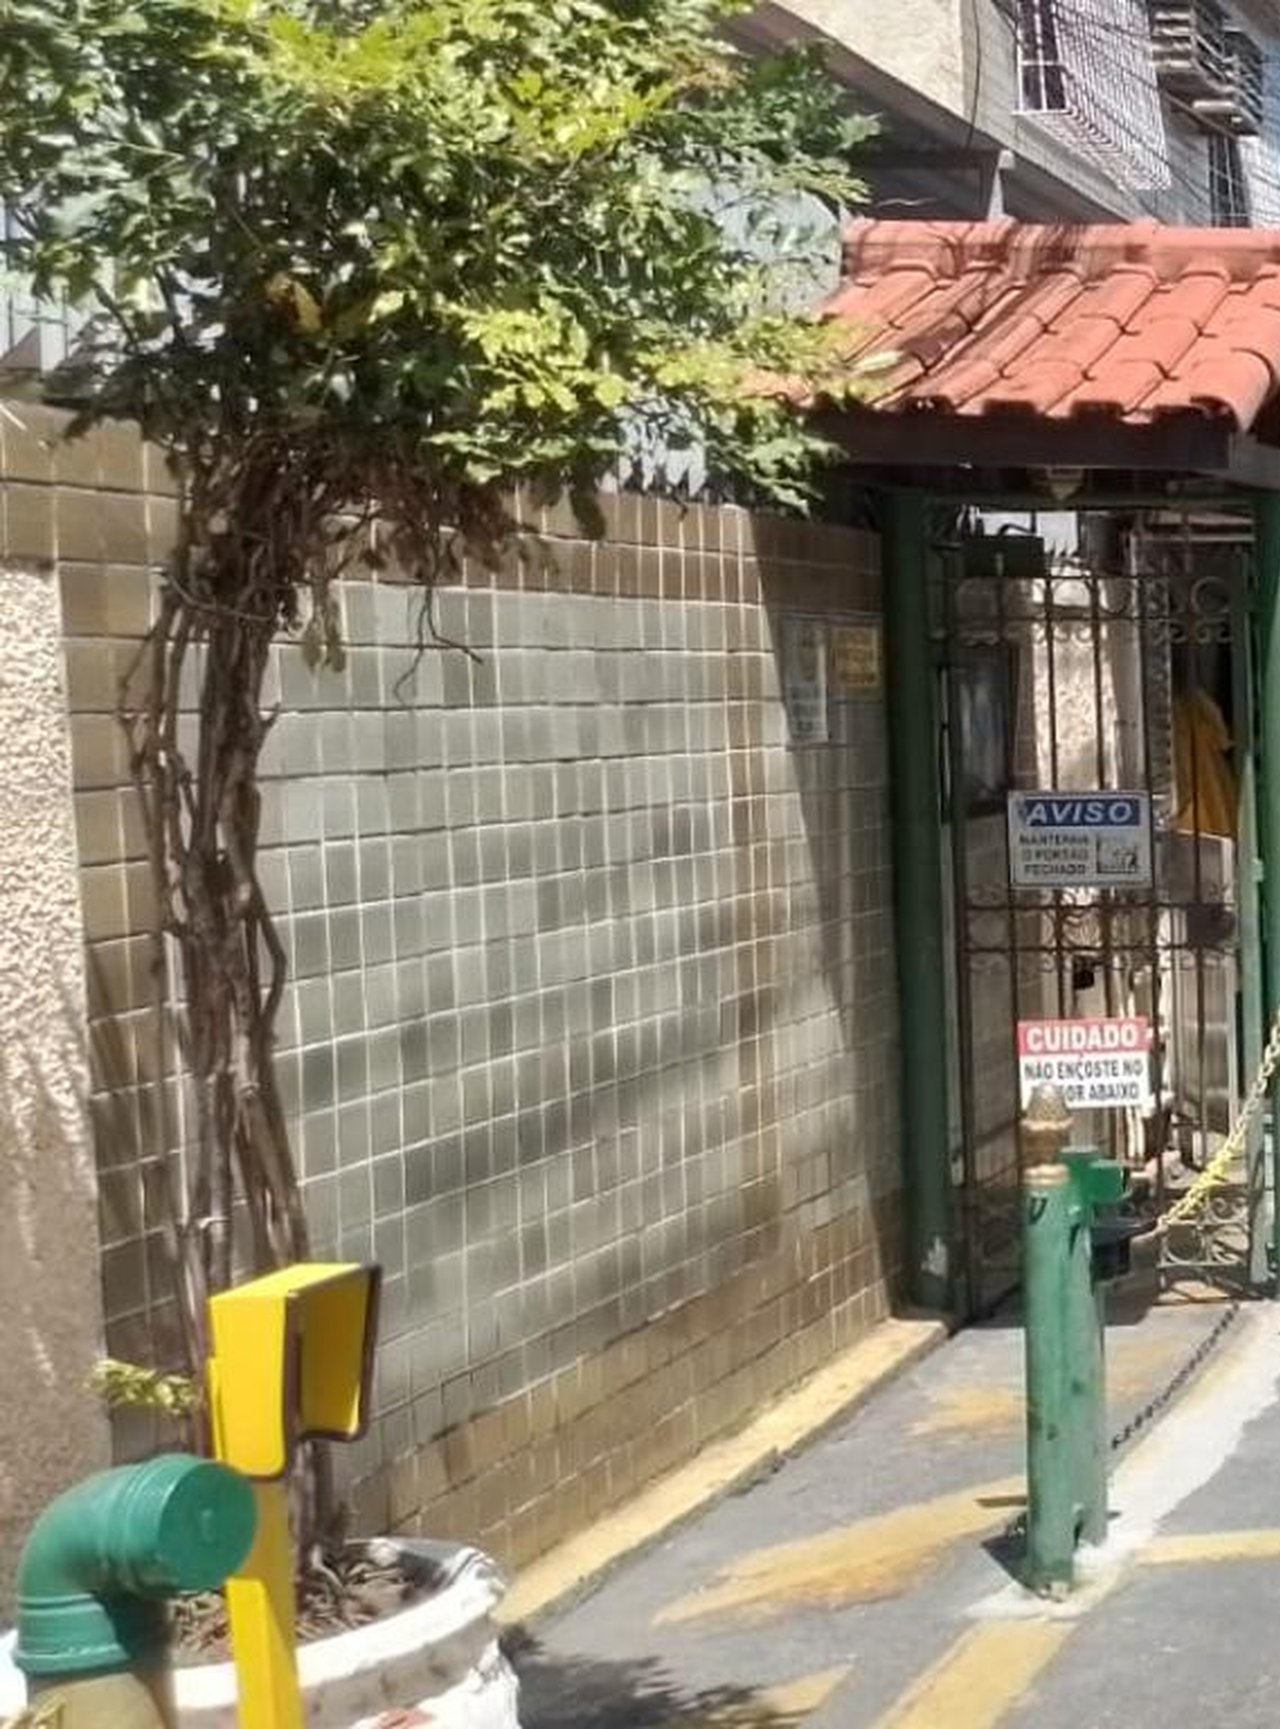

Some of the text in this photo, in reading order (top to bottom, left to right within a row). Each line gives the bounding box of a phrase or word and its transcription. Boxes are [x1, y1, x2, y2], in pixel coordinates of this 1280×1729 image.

[1026, 801, 1132, 824] AVISO
[1024, 864, 1086, 874] FECHADO
[1026, 1024, 1138, 1051] CUIDADO
[1122, 1059, 1143, 1077] NO
[1089, 1083, 1139, 1100] ABAIXO
